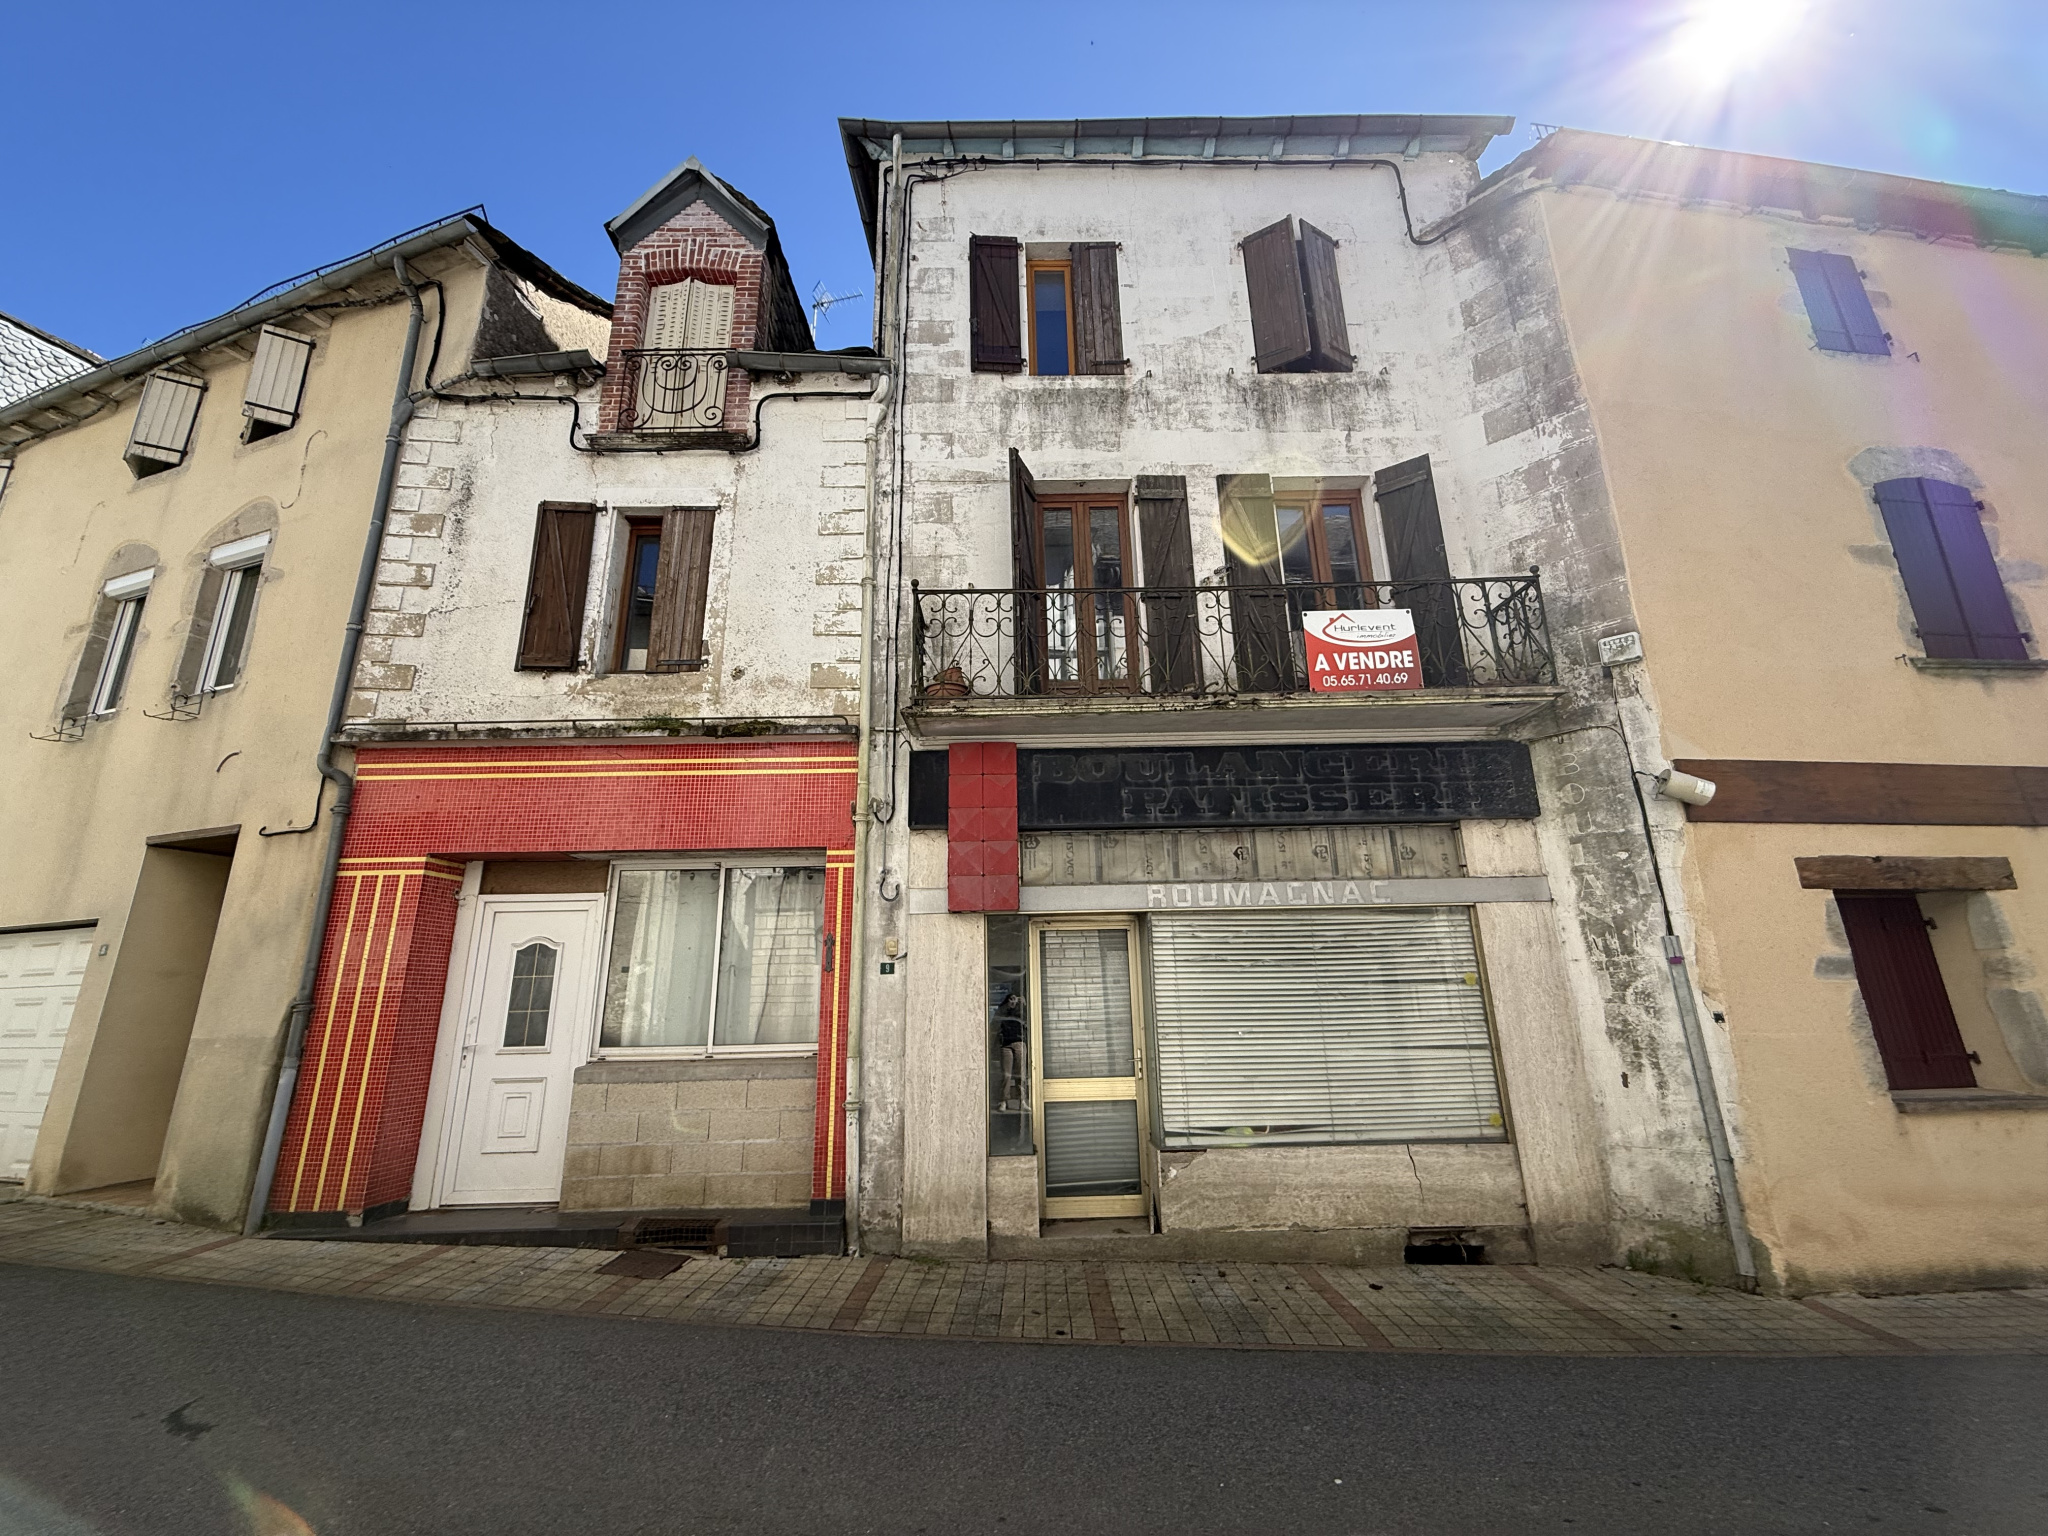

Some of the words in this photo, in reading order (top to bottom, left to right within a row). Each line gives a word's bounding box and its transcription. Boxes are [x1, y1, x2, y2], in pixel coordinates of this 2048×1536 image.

[1314, 653, 1331, 672] A
[1333, 650, 1414, 671] VENDRE
[1322, 672, 1409, 687] 05.65.71.40.69
[1147, 880, 1391, 908] ROUMAGNAC
[885, 963, 890, 973] 9
